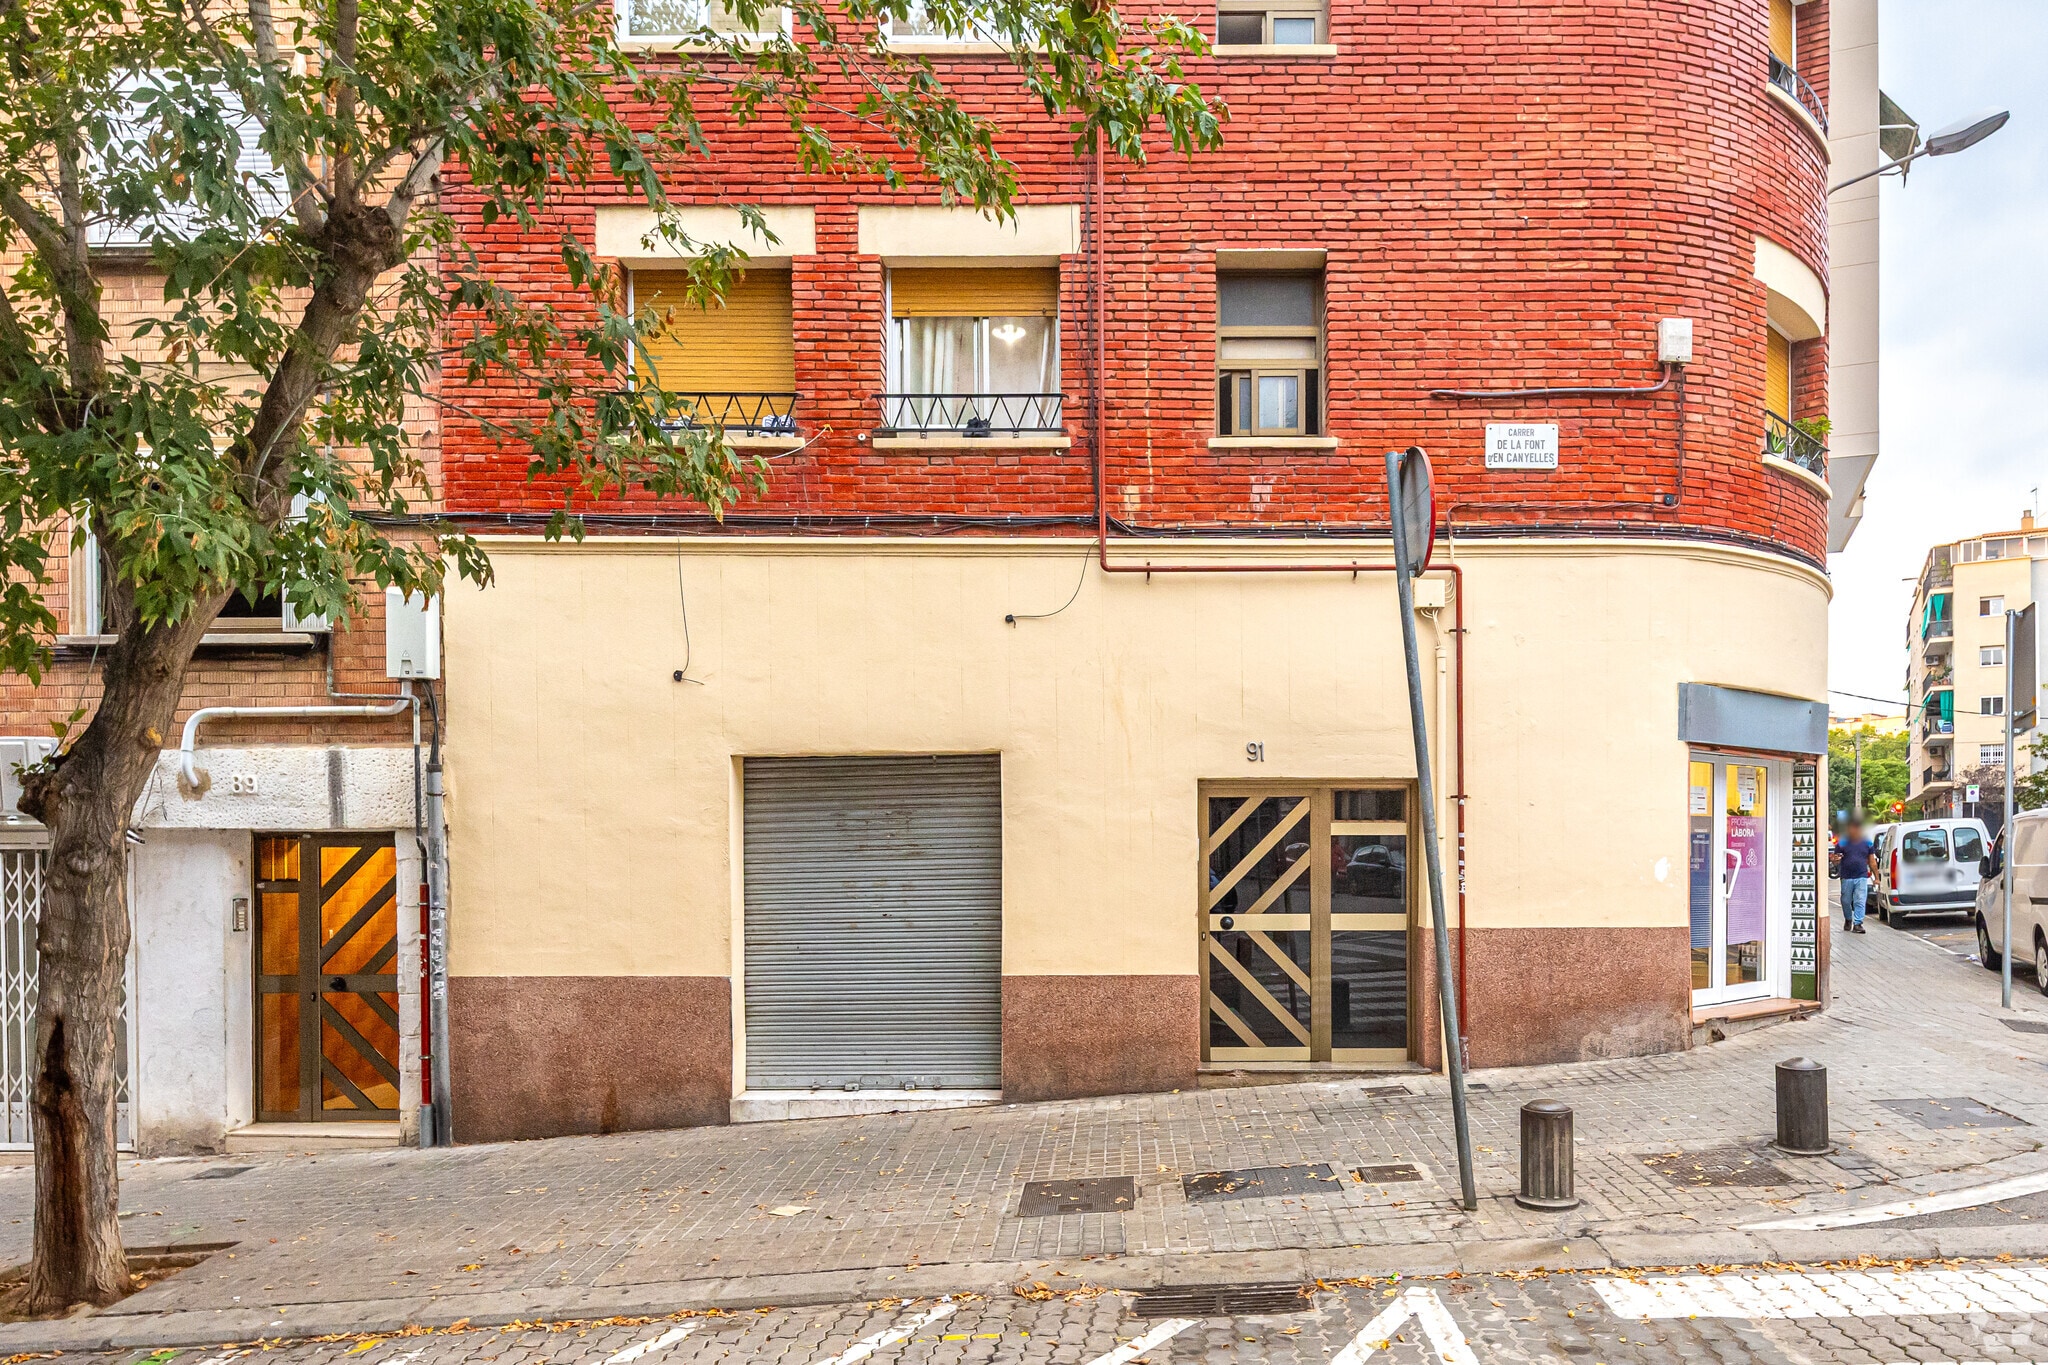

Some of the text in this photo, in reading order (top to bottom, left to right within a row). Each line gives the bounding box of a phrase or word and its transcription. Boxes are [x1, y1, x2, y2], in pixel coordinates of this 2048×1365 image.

[1508, 428, 1535, 437] CARRER
[1497, 439, 1545, 450] DE LA FONT
[1506, 452, 1555, 463] CANYELLES
[1246, 741, 1265, 763] 91
[231, 774, 258, 794] 89
